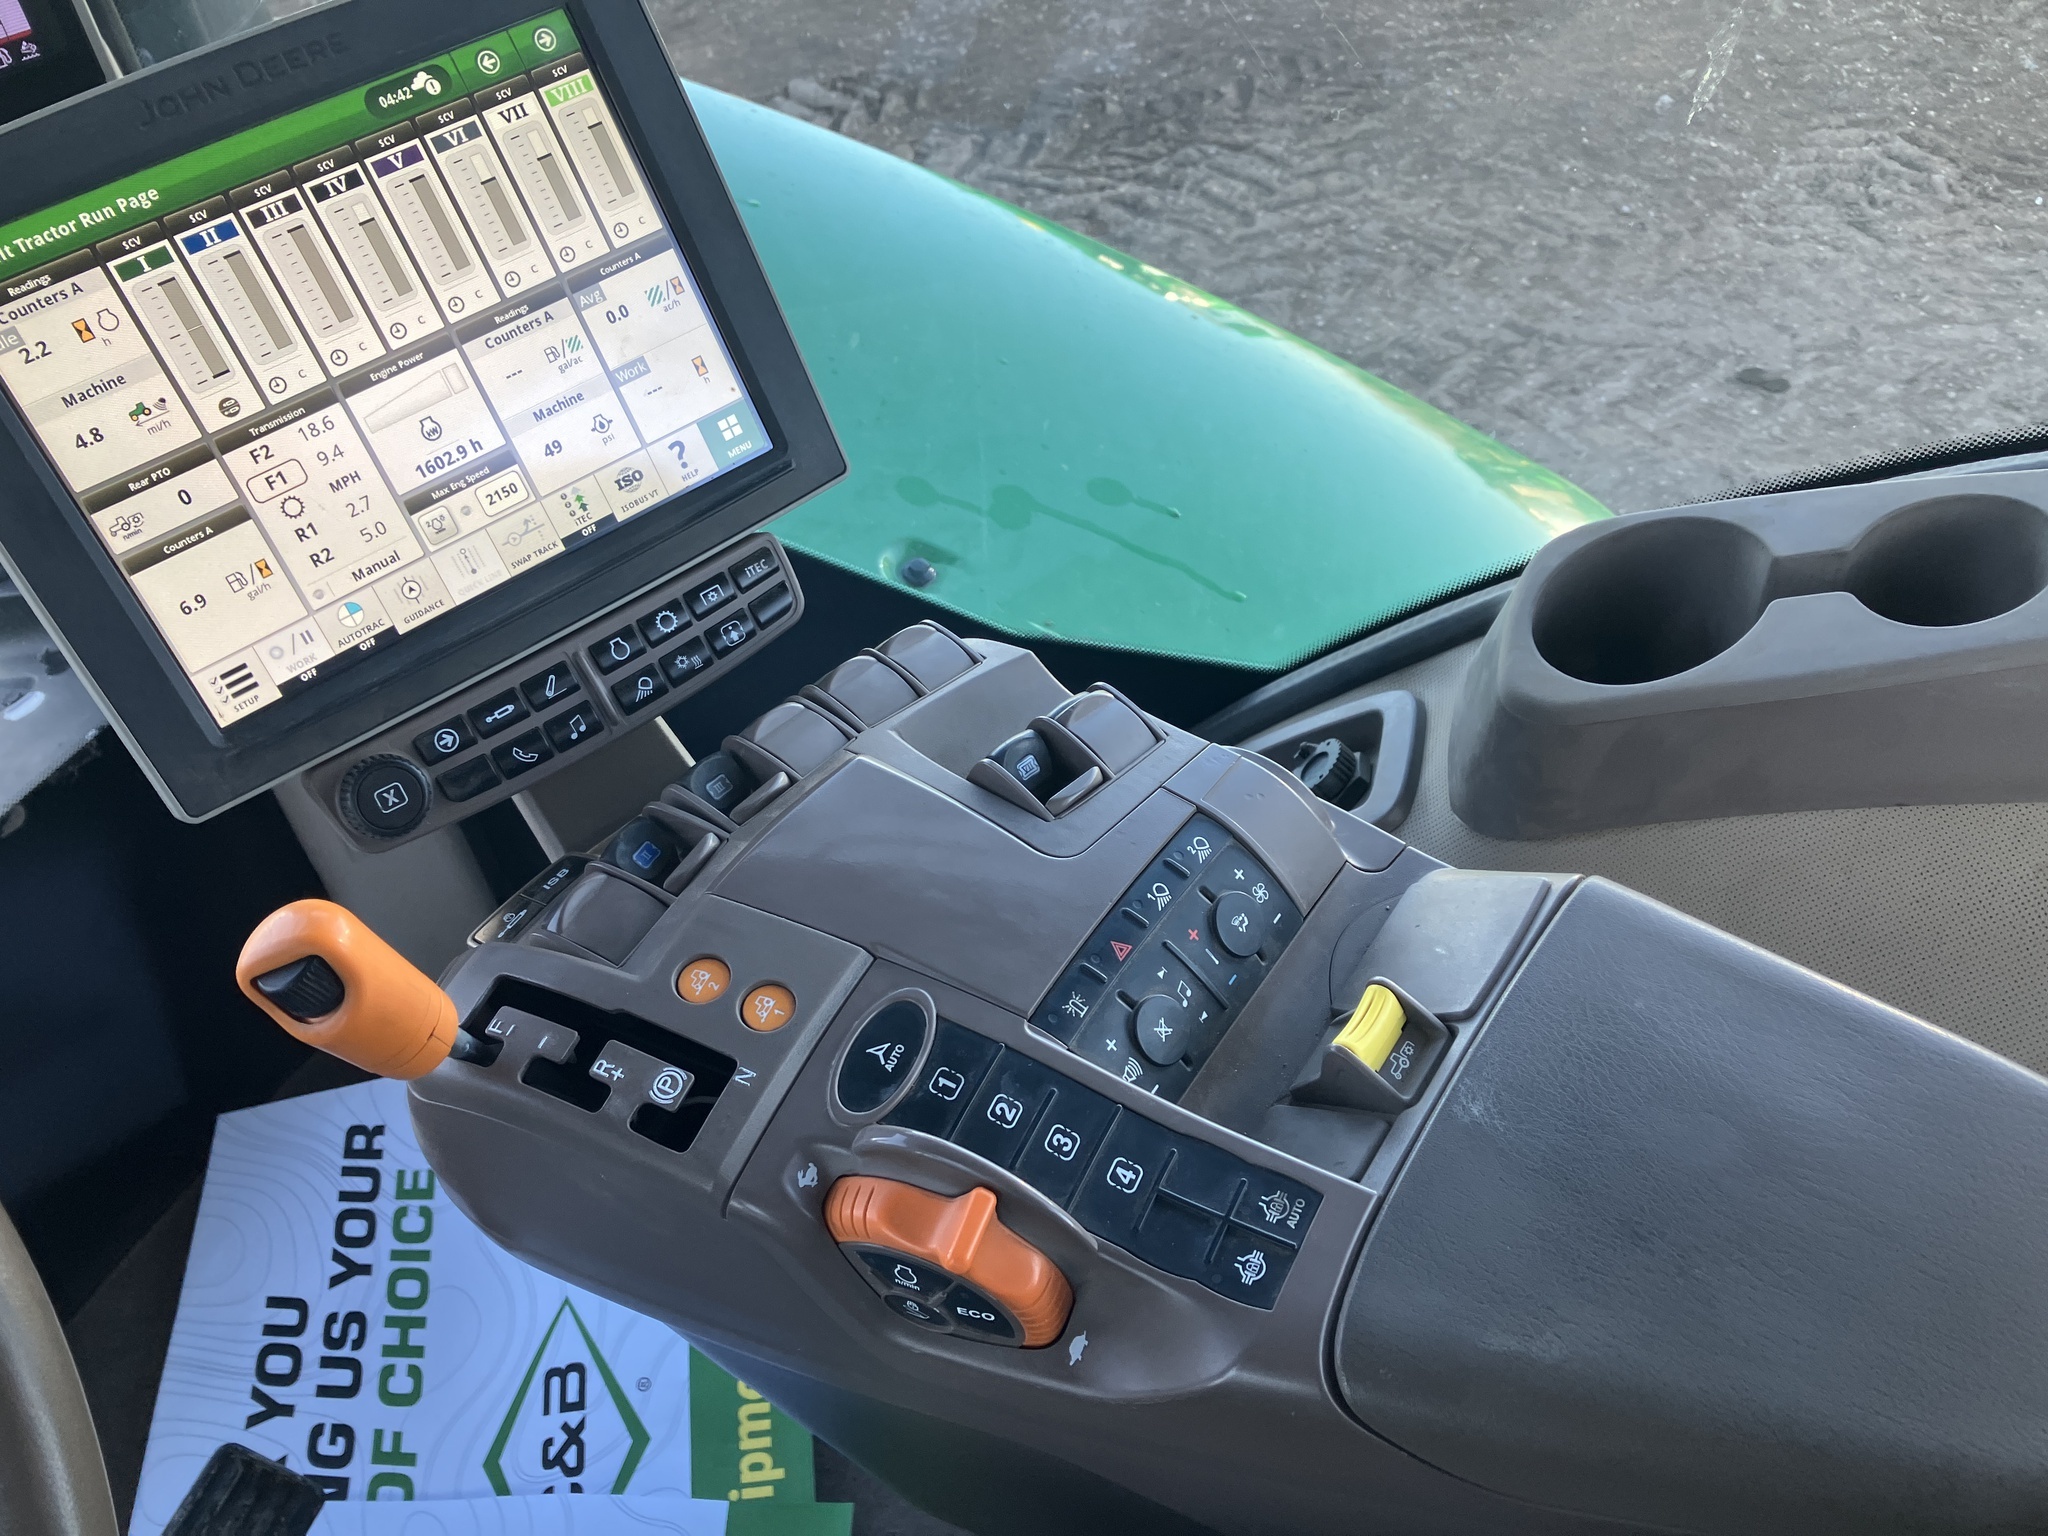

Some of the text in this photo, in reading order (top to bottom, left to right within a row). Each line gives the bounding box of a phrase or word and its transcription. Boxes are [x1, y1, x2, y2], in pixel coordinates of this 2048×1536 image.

[138, 31, 345, 131] JOHN DEERE
[552, 64, 568, 78] SCV
[378, 86, 414, 109] 04:42
[496, 87, 513, 101] SCV
[437, 110, 455, 124] SCV
[497, 102, 530, 125] VII
[378, 134, 395, 148] SCV
[443, 127, 468, 147] VI
[317, 158, 335, 173] SCV
[387, 152, 404, 169] V
[254, 183, 272, 198] SCV
[324, 175, 349, 197] IV
[12, 219, 78, 254] Tractor
[78, 205, 116, 228] Run
[116, 188, 159, 212] Page
[189, 209, 208, 224] SCV
[261, 199, 290, 222] III
[122, 235, 142, 250] SCV
[599, 251, 643, 277] Counters A
[7, 274, 52, 298] Readings
[71, 282, 84, 296] A
[580, 289, 605, 309] Avg
[663, 299, 681, 313] ac/h
[493, 303, 530, 326] Readings
[605, 304, 630, 325] 0.0
[484, 310, 555, 350] Counters A
[18, 340, 52, 365] 2.2
[101, 336, 112, 347] h
[369, 351, 425, 383] Engine Power
[557, 354, 584, 375] gal/ac
[615, 361, 648, 383] Work
[60, 372, 127, 410] Machine
[532, 390, 585, 424] Machine
[146, 418, 173, 437] mi/h
[248, 407, 307, 437] Transmission
[74, 427, 105, 451] 4.8
[249, 415, 336, 465] F2 18.6
[542, 438, 564, 460] 49
[601, 433, 617, 446] psi
[727, 441, 753, 459] MENU
[264, 444, 345, 491] F1 9.4
[414, 437, 484, 479] 1602.9 h
[128, 466, 171, 493] Rear PTO
[328, 470, 363, 494] MPH
[431, 466, 491, 501] Max Eng Speed
[613, 469, 644, 492] ISO
[681, 468, 701, 483] HELP
[177, 489, 193, 506] 0
[485, 482, 519, 507] 2150
[620, 488, 660, 514] ISOBUS VT
[293, 495, 373, 543] R1 2.7
[574, 511, 593, 527] iTEC
[581, 523, 598, 537] OFF
[122, 527, 144, 542] n/min
[163, 526, 215, 555] Counters A
[309, 521, 388, 568] R2 5.0
[510, 540, 560, 570] SWAP TRACK
[351, 550, 402, 583] Manual
[744, 558, 769, 578] iTEC
[246, 582, 272, 602] gal/h
[179, 593, 209, 617] 6.9
[403, 599, 445, 625] GUIDANCE
[337, 618, 386, 649] AUTOTRAC
[358, 637, 377, 652] OFF
[286, 652, 319, 674] WORK
[299, 667, 318, 683] OFF
[232, 693, 261, 714] SETUP
[884, 1043, 906, 1073] AUTO
[734, 1065, 757, 1087] N
[938, 1075, 957, 1090] 1
[995, 1102, 1016, 1122] 2
[1052, 1132, 1073, 1152] 3
[1115, 1165, 1138, 1185] 4
[328, 1124, 387, 1290] YOUR
[1286, 1197, 1306, 1230] AUTO
[378, 1169, 436, 1407] CHOICE
[894, 1278, 921, 1292] n/min
[956, 1306, 996, 1322] ECO
[244, 1295, 310, 1430] YOU
[315, 1310, 368, 1400] US
[541, 1361, 588, 1494] &B
